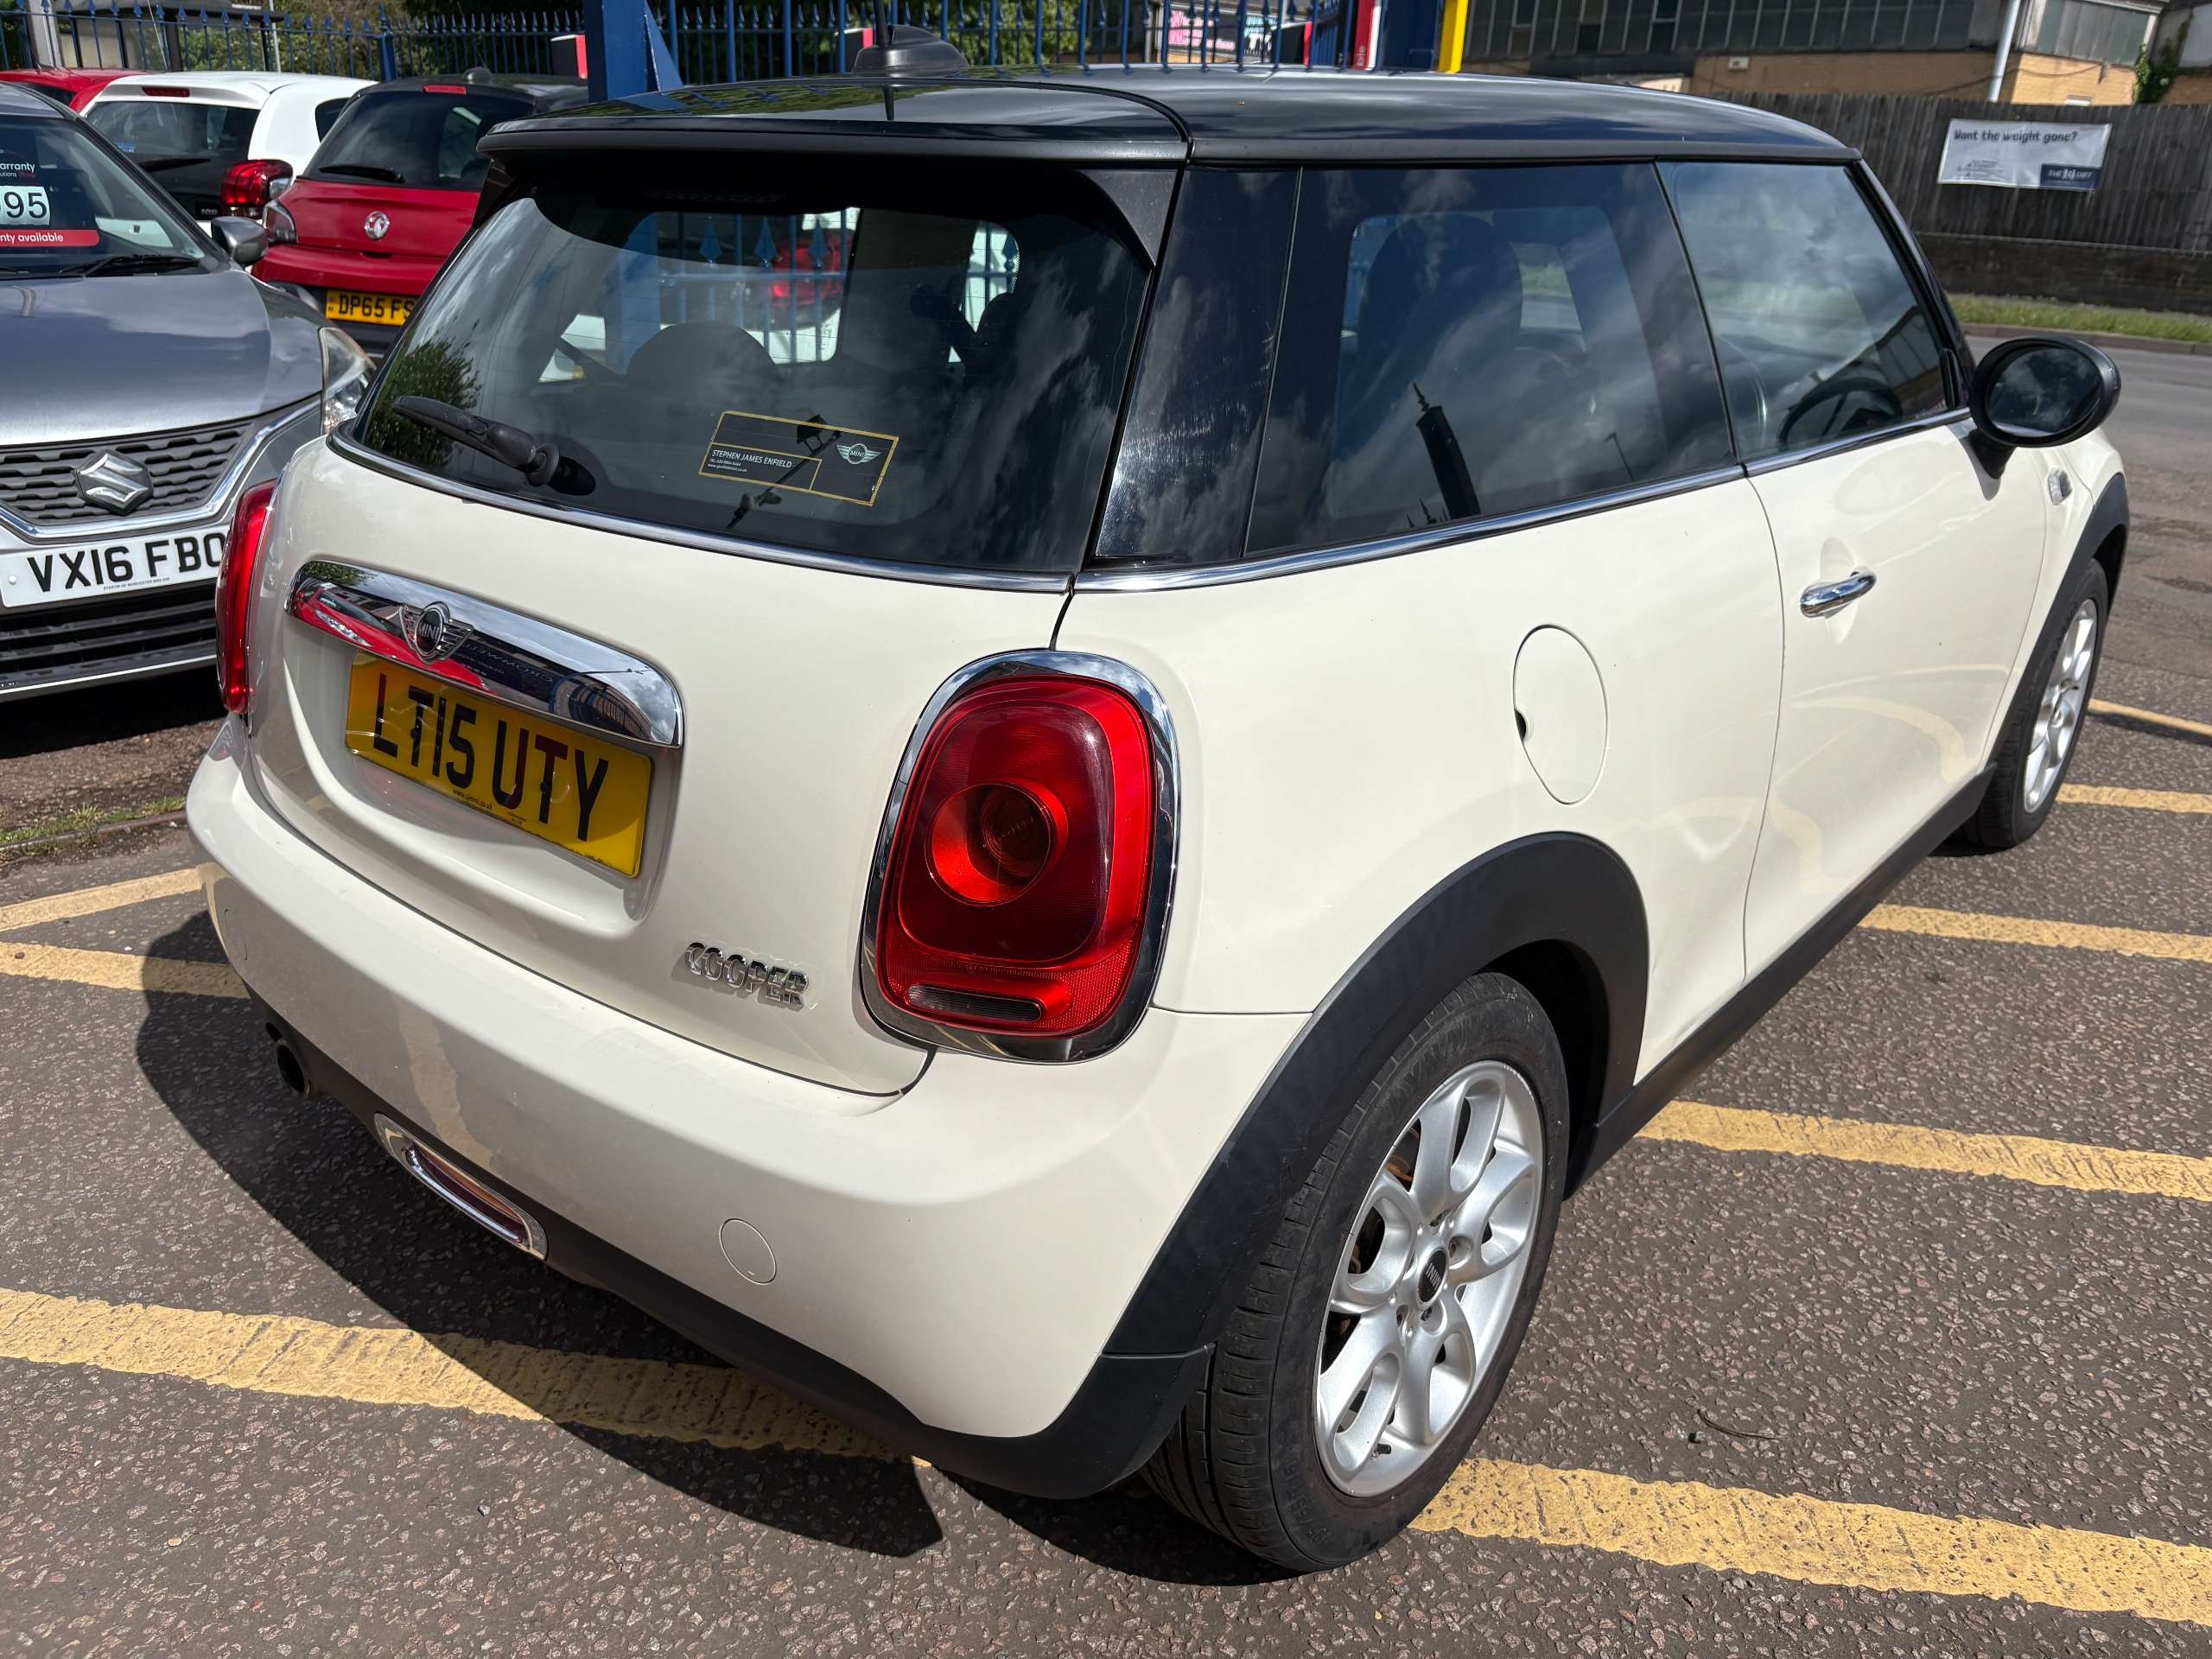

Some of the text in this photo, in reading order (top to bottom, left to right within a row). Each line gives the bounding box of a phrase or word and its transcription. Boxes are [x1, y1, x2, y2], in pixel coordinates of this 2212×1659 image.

[1955, 130, 2078, 143] Want the weight gone?
[0, 191, 48, 219] 95
[18, 232, 64, 242] available
[338, 294, 385, 318] DP65
[711, 449, 792, 467] STEPHEN JAMES ENFIELD
[27, 532, 226, 592] VX16 FBO
[419, 620, 441, 639] MINI
[373, 673, 609, 842] LT15 UTY
[685, 942, 809, 1005] COOPER
[1425, 1262, 1442, 1291] MINI
